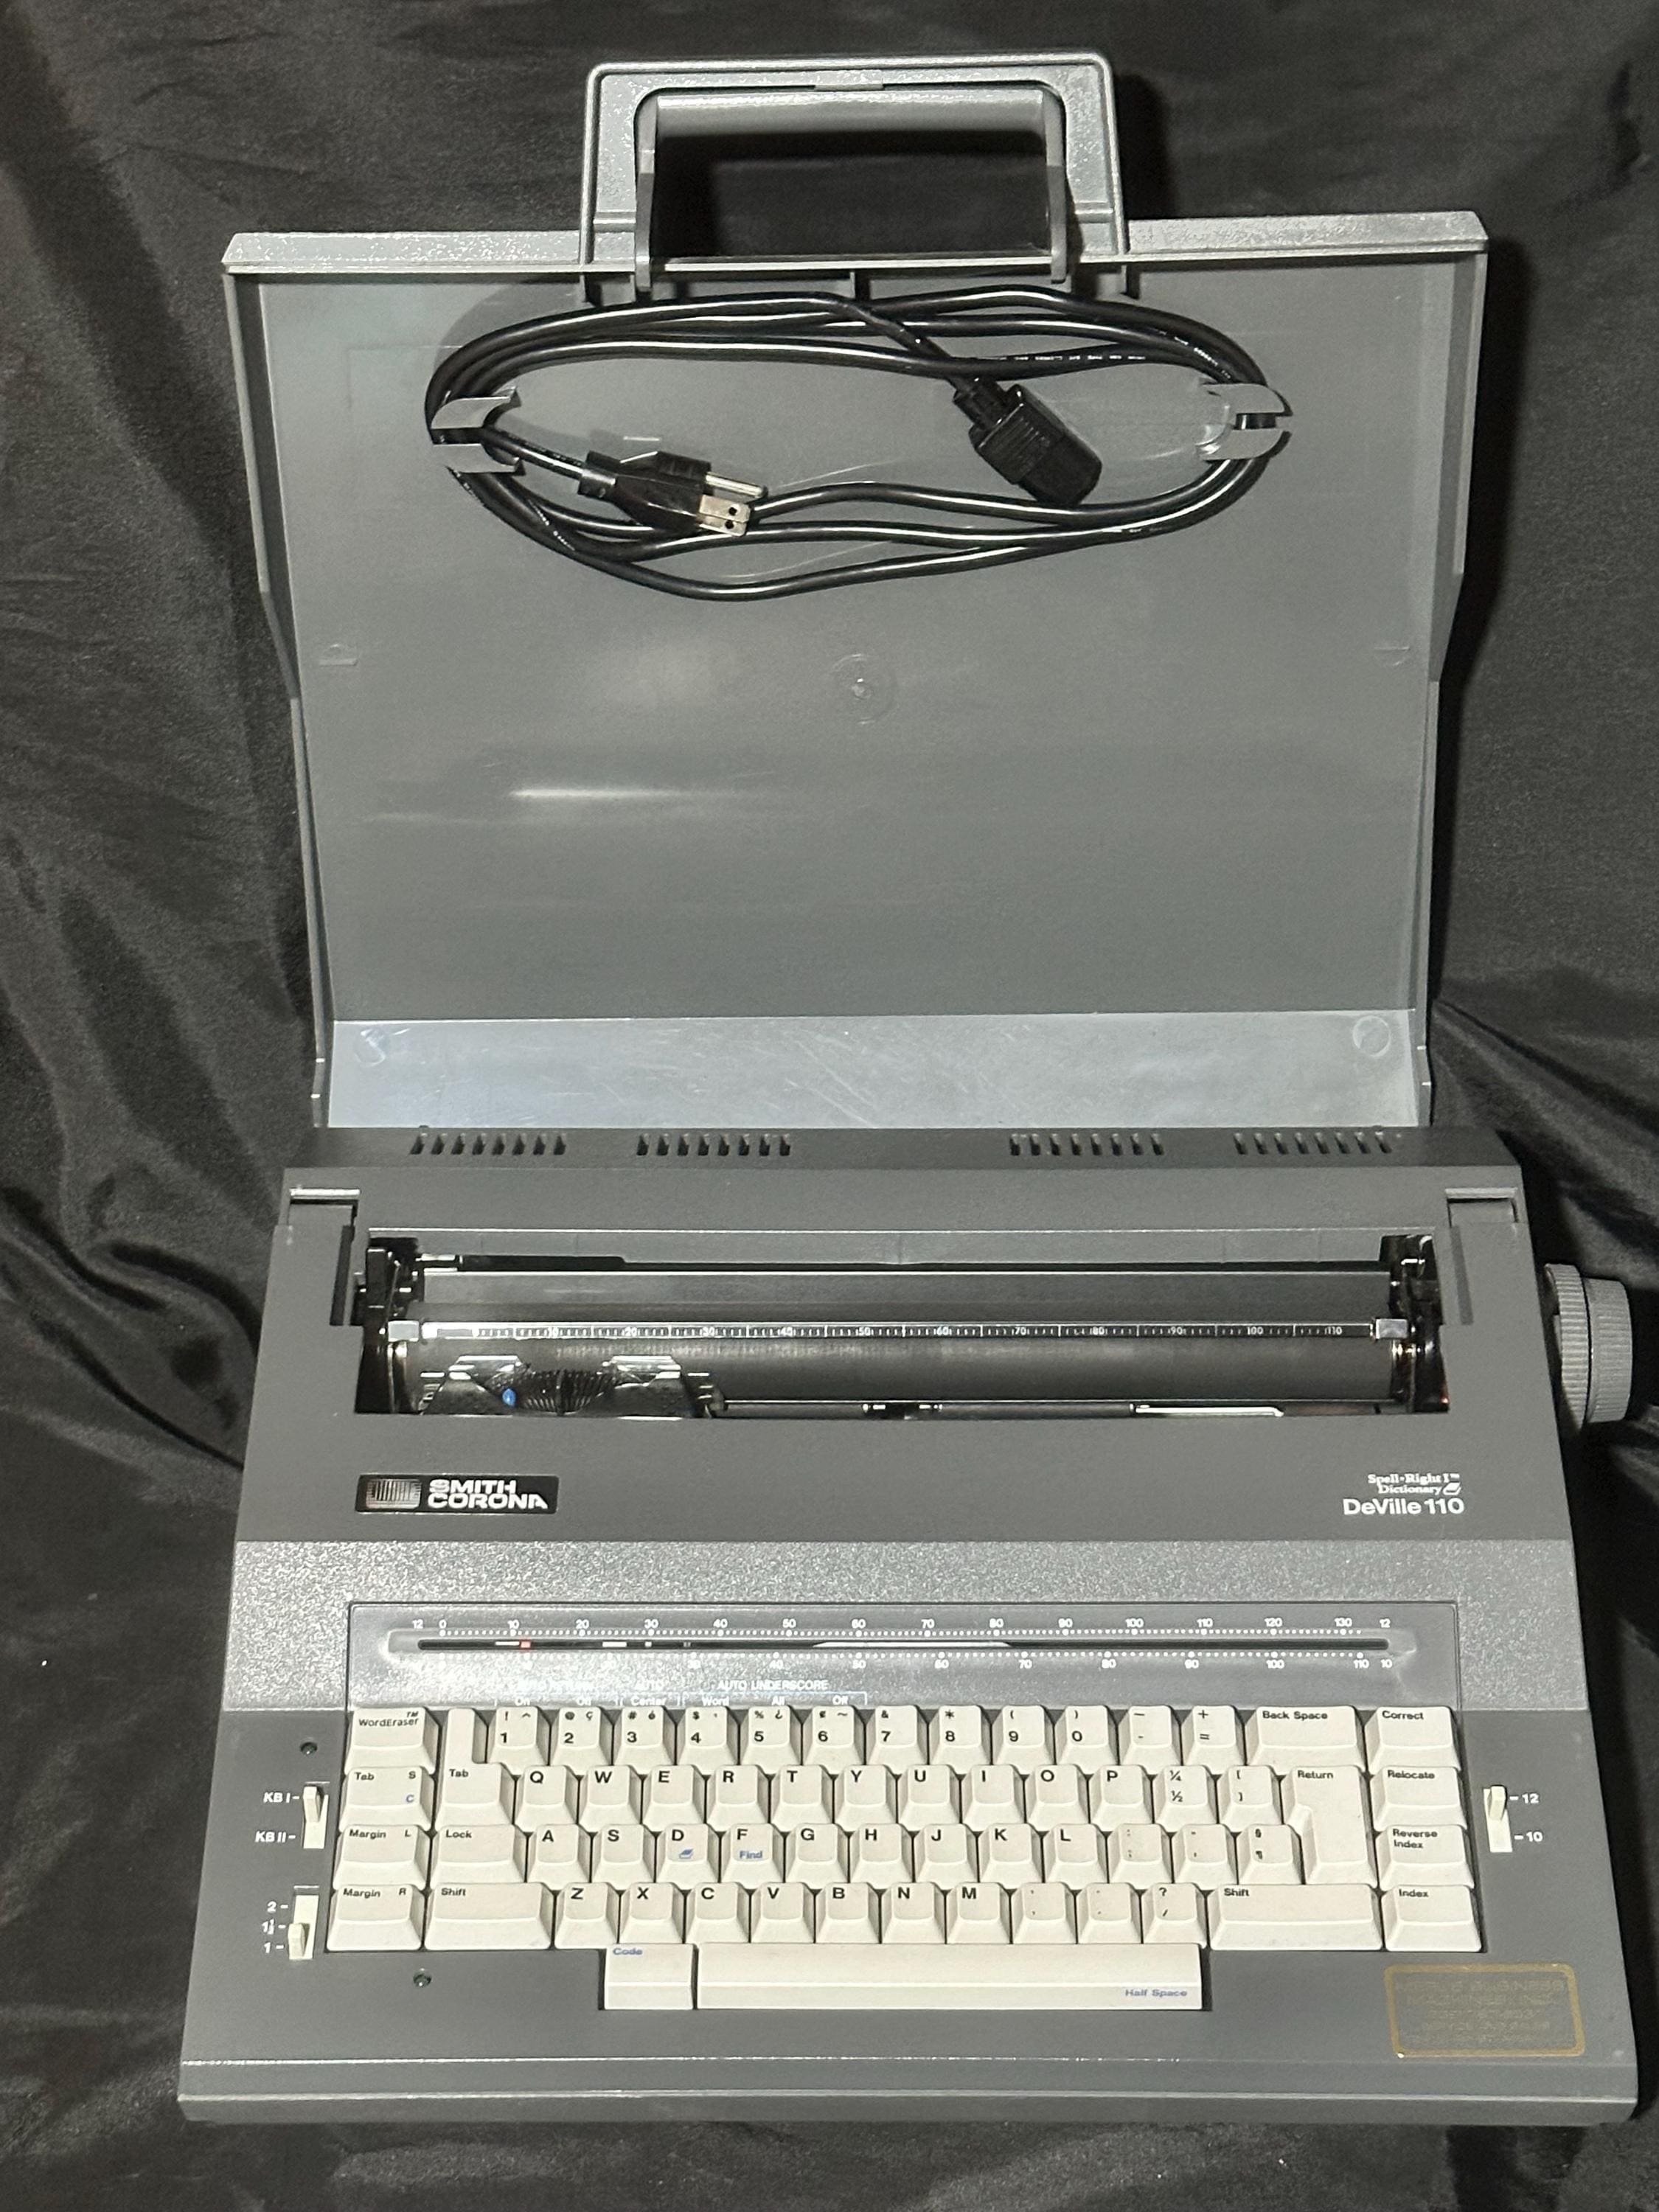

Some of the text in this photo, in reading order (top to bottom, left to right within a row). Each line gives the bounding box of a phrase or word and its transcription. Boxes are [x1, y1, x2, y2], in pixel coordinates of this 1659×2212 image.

[625, 1327, 637, 1338] 20
[703, 1326, 715, 1337] 30
[780, 1326, 793, 1337] 40
[858, 1326, 871, 1337] 50
[936, 1326, 949, 1337] 60
[1015, 1326, 1027, 1337] 70
[1092, 1326, 1105, 1336] 80
[1171, 1326, 1183, 1336] 90
[1247, 1326, 1264, 1336] 100
[1327, 1326, 1343, 1335] 110
[429, 1479, 517, 1494] SMITH
[1378, 1484, 1443, 1495] Dictionary
[428, 1493, 549, 1509] CORONA
[1343, 1498, 1464, 1514] DeVille 110
[412, 1617, 1391, 1630] 12 0 10 20 30 40 50 60 70 80 90 100 110 120 130 12
[769, 1660, 784, 1669] 40
[852, 1660, 866, 1669] 50
[934, 1660, 949, 1669] 60
[1018, 1659, 1032, 1669] 70
[1101, 1659, 1116, 1669] 80
[1184, 1659, 1199, 1669] 90
[1266, 1659, 1284, 1669] 100
[1354, 1659, 1369, 1669] 110
[1380, 1659, 1392, 1669] 10
[717, 1680, 830, 1691] AUTO UNDERSCORE
[630, 1697, 666, 1706] Center
[702, 1697, 729, 1706] Word
[771, 1697, 785, 1706] All
[832, 1696, 849, 1705] Off
[628, 1711, 638, 1720] #
[692, 1711, 700, 1720] $
[754, 1711, 765, 1719] %
[881, 1710, 889, 1719] &
[1262, 1711, 1328, 1721] Back Space
[1382, 1710, 1425, 1720] Correct
[359, 1718, 419, 1727] WordEraser
[500, 1733, 508, 1743] 1
[564, 1733, 574, 1744] 2
[627, 1732, 637, 1743] 3
[691, 1732, 702, 1743] 4
[754, 1731, 765, 1742] 5
[818, 1731, 828, 1742] 6
[881, 1731, 891, 1742] 7
[945, 1731, 956, 1742] 8
[1009, 1731, 1019, 1742] 9
[355, 1771, 416, 1781] Tab S
[449, 1769, 469, 1777] Tab
[529, 1771, 544, 1784] Q
[595, 1771, 613, 1783] W
[658, 1771, 670, 1783] E
[723, 1770, 734, 1783] R
[787, 1770, 798, 1783] T
[850, 1770, 862, 1783] Y
[914, 1770, 926, 1782] U
[981, 1770, 986, 1782] I
[1040, 1770, 1054, 1782] O
[1107, 1770, 1118, 1782] P
[1298, 1770, 1334, 1779] Return
[1388, 1770, 1435, 1779] Relocate
[263, 1792, 291, 1803] KB I
[406, 1795, 414, 1803] C
[1522, 1793, 1539, 1804] 12
[255, 1832, 274, 1843] KB
[349, 1829, 411, 1840] Margin L
[445, 1829, 472, 1838] Lock
[542, 1829, 554, 1842] A
[608, 1829, 620, 1842] S
[672, 1829, 684, 1841] D
[737, 1829, 748, 1840] F
[801, 1829, 815, 1840] G
[865, 1829, 877, 1841] H
[931, 1829, 942, 1841] J
[995, 1829, 1007, 1841] K
[1060, 1829, 1071, 1842] L
[1393, 1829, 1438, 1838] Reverse
[1526, 1831, 1543, 1842] 10
[1394, 1839, 1423, 1848] Index
[740, 1851, 763, 1860] Find
[343, 1888, 406, 1899] Margin R
[441, 1888, 466, 1896] Shift
[571, 1888, 584, 1900] Z
[636, 1887, 649, 1900] X
[701, 1887, 714, 1900] C
[768, 1887, 779, 1899] V
[832, 1887, 845, 1899] B
[897, 1887, 910, 1899] N
[961, 1887, 976, 1899] M
[1158, 1887, 1167, 1896] ?
[1224, 1888, 1250, 1896] Shift
[1399, 1888, 1429, 1898] Index
[267, 1901, 276, 1912] 2
[263, 1942, 271, 1953] 1
[613, 1947, 643, 1955] Code
[1125, 1989, 1187, 1997] Half Space
